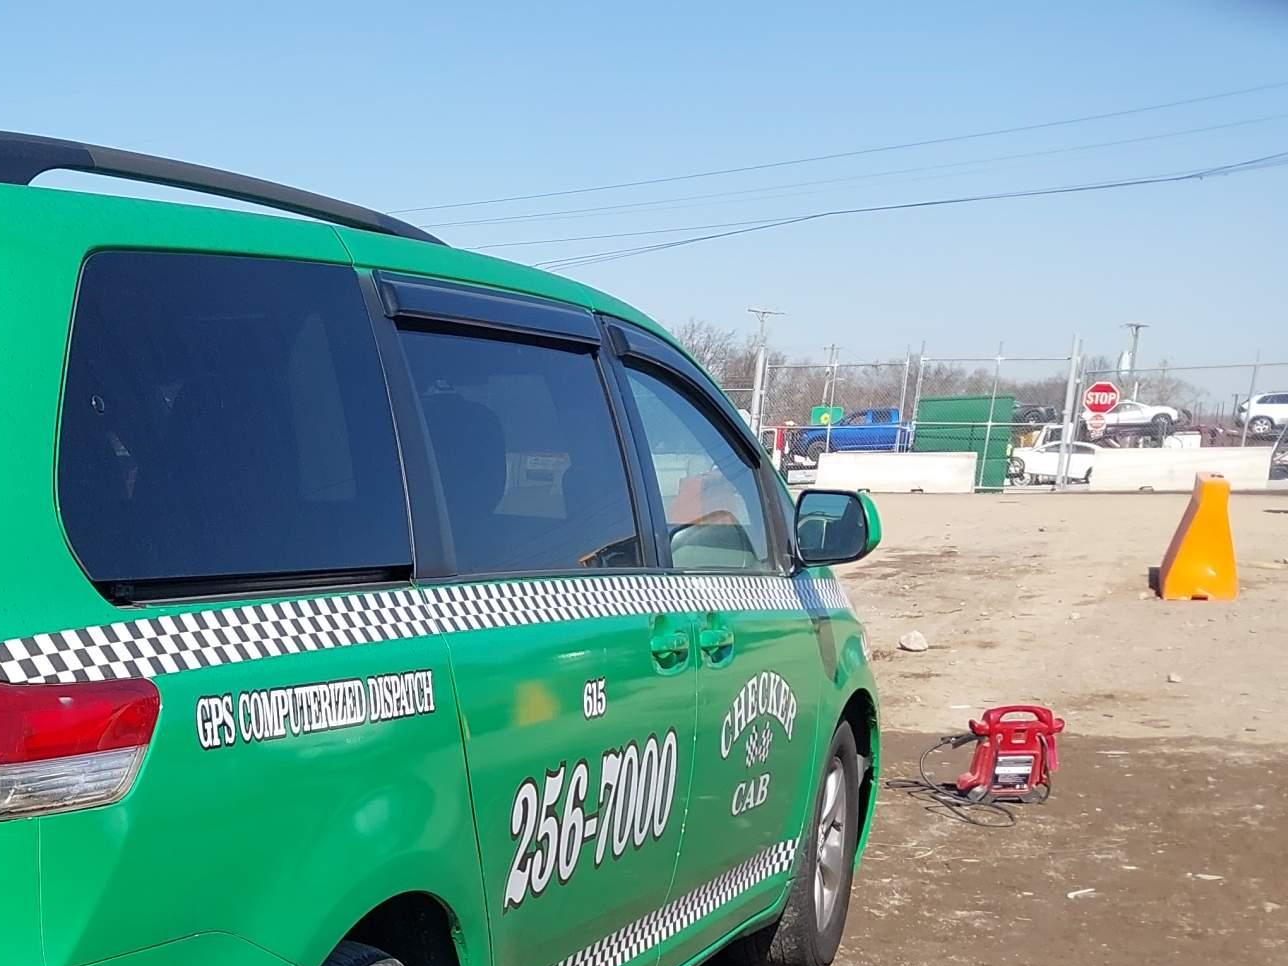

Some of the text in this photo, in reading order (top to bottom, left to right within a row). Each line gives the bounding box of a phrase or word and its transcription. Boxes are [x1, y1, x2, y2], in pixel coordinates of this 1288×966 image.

[1086, 391, 1117, 405] STOP
[196, 670, 435, 749] GPS COMPUTERIZED DISPATCH
[583, 677, 606, 719] 615
[721, 671, 797, 759] CHECKER
[503, 728, 678, 912] 256-7000
[732, 773, 770, 816] CAB
